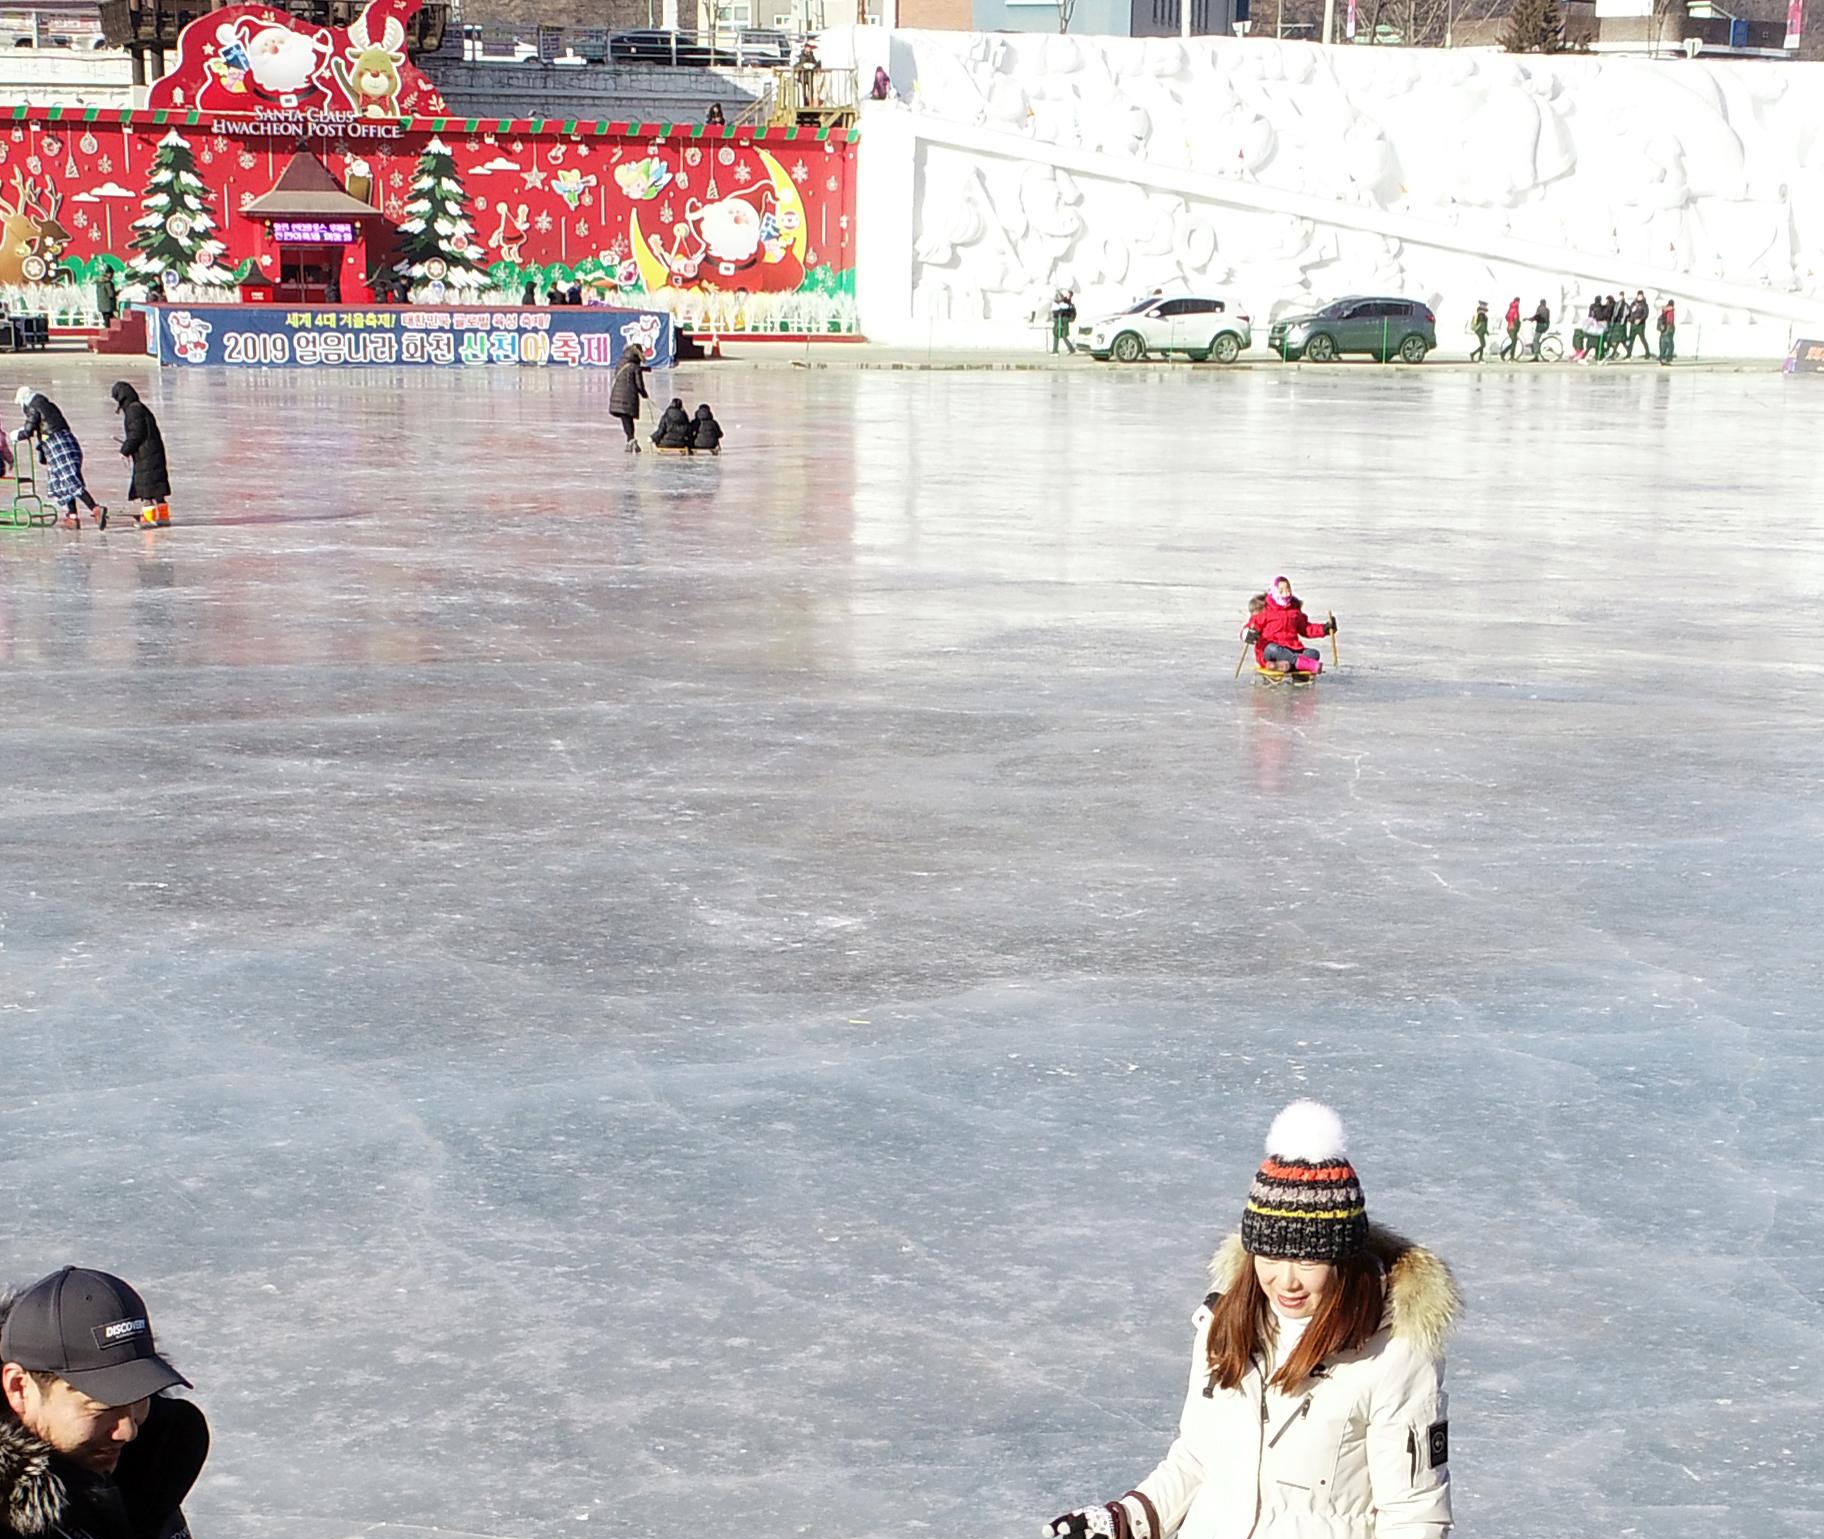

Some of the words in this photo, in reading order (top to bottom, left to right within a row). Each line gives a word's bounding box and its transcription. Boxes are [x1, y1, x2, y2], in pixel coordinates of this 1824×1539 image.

[254, 106, 302, 122] SANTA
[307, 107, 354, 124] CLAUS
[212, 119, 303, 136] HWACHEON
[308, 122, 346, 137] POST
[347, 123, 403, 139] OFFICE
[285, 312, 312, 329] 세계
[314, 312, 337, 329] 4대
[339, 312, 396, 329] 겨울축제!
[401, 313, 451, 330] 대한민국
[224, 332, 289, 363] 2019
[294, 332, 397, 364] 얼음나라
[401, 332, 454, 364] 화천
